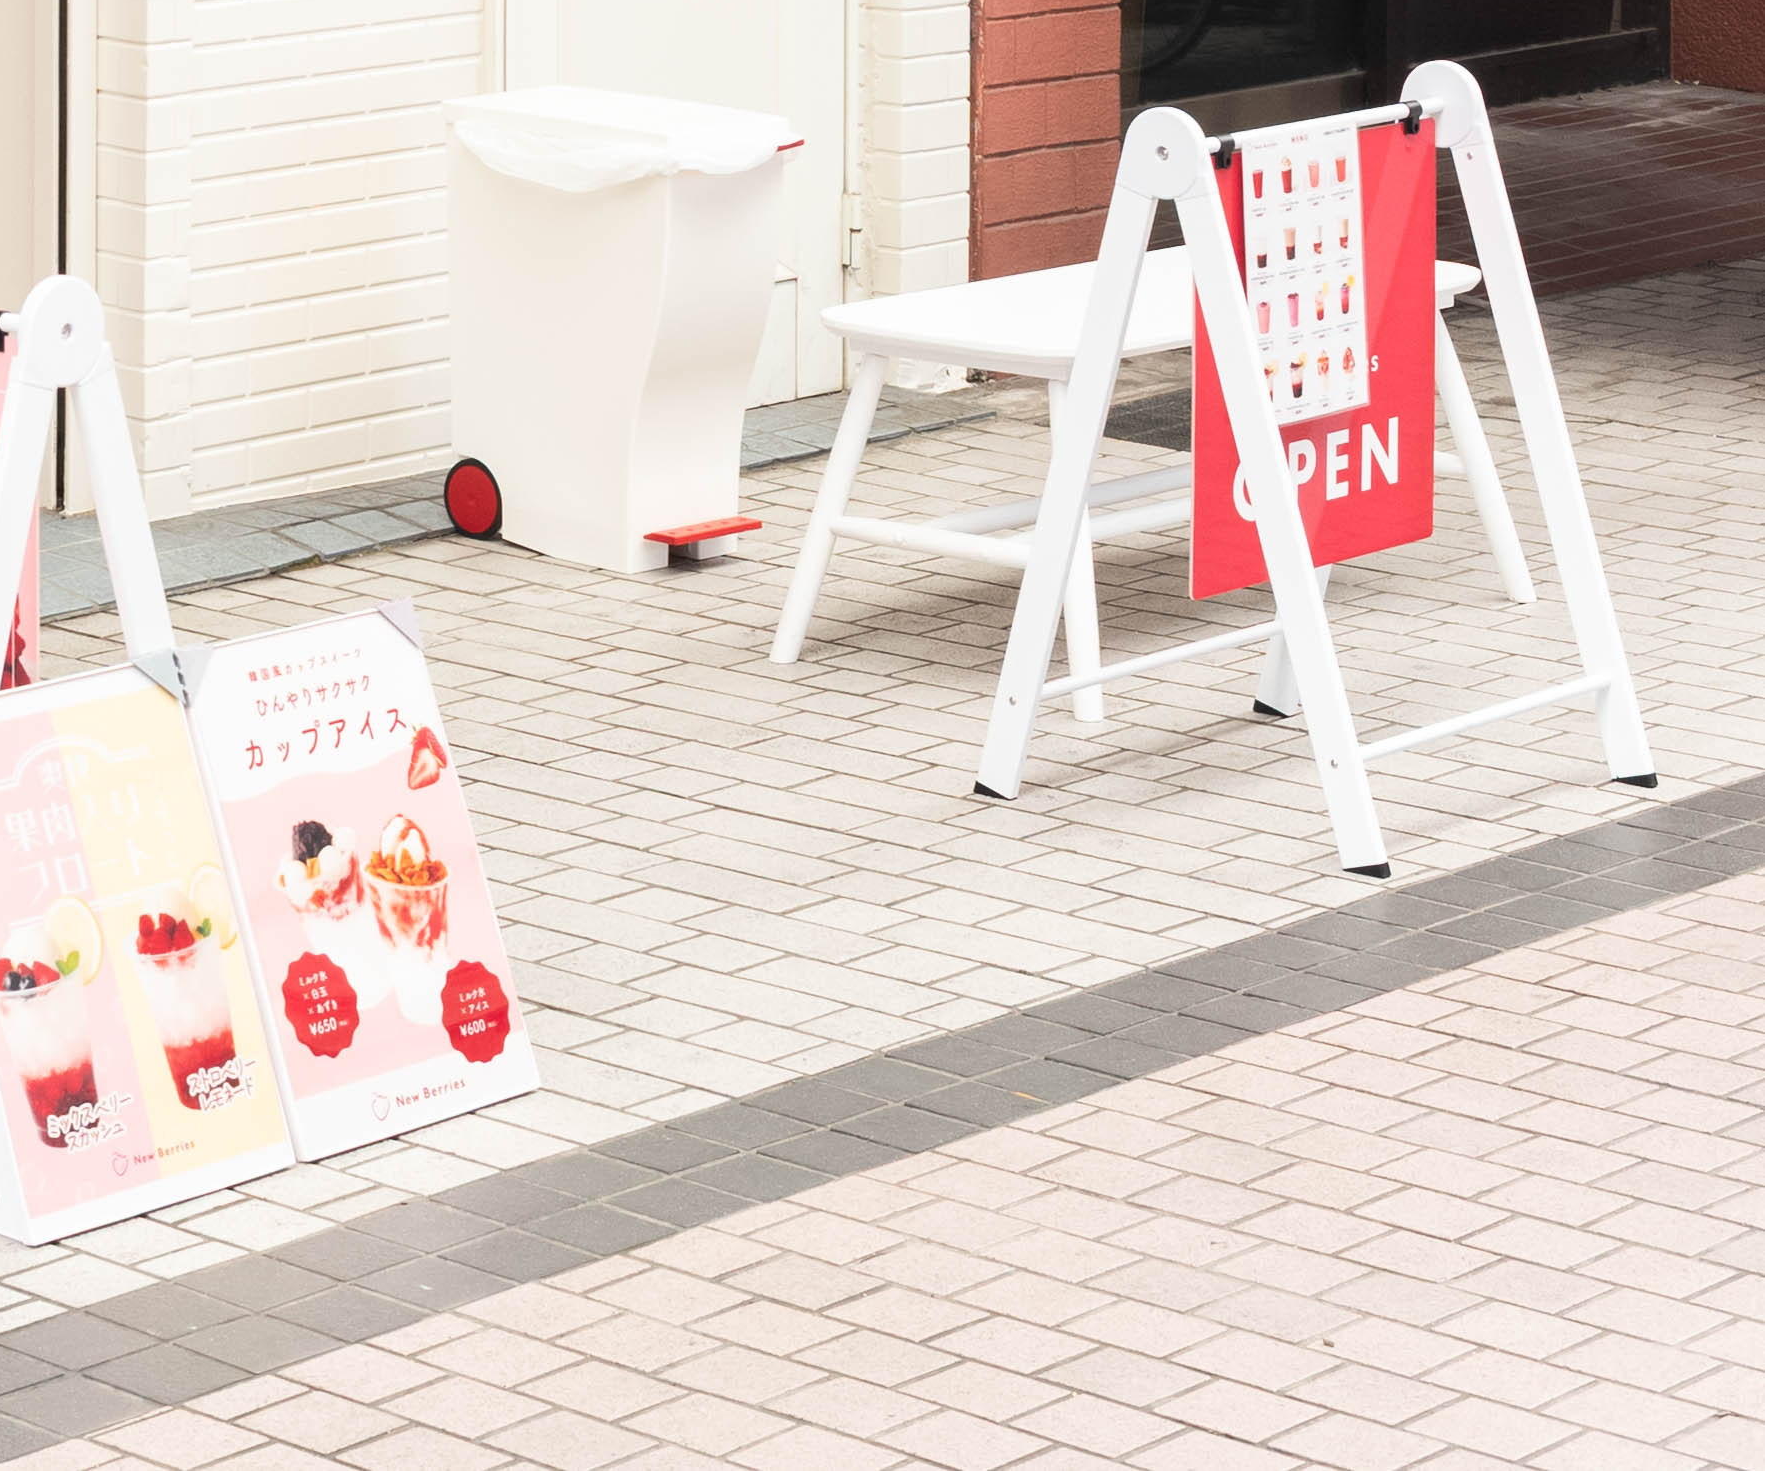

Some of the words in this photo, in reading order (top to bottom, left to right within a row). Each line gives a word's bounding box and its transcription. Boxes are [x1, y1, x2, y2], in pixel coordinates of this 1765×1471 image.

[255, 674, 370, 717] ひんやりサクサク
[245, 708, 408, 770] カップアイス
[308, 1017, 337, 1036] ¥650
[459, 1018, 486, 1037] ¥600
[187, 1058, 257, 1095] ストロベリー
[396, 1094, 419, 1107] New
[422, 1079, 466, 1100] Berries
[47, 1095, 132, 1137] ミックスベリー
[66, 1123, 125, 1150] スカッシュ
[133, 1154, 155, 1166] New
[157, 1140, 196, 1159] Berries
